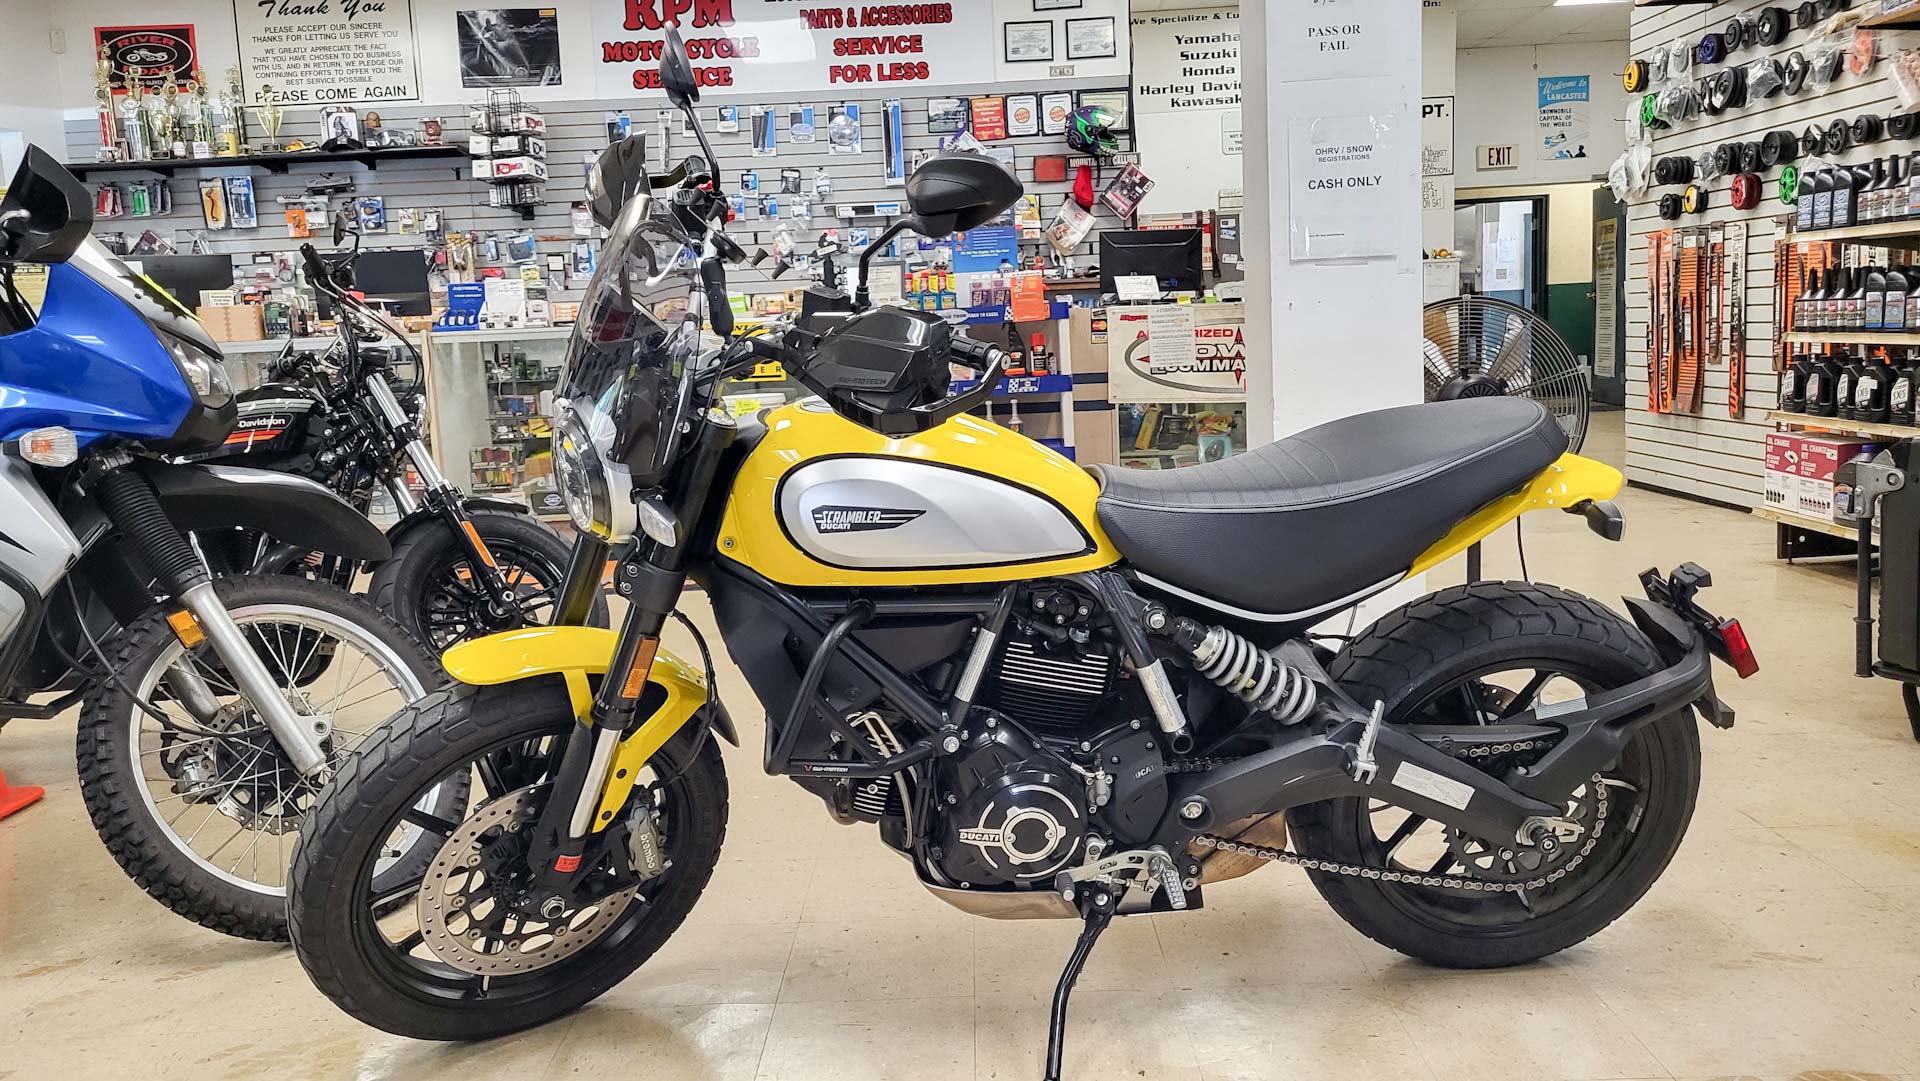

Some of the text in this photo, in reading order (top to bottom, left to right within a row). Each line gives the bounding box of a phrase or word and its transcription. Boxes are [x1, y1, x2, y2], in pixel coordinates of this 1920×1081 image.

[258, 0, 386, 21] Thank You
[624, 0, 736, 30] RPM
[800, 3, 952, 29] PARTS & ACCESSORIES
[1150, 14, 1208, 25] Specialize
[264, 22, 383, 34] PLEASE ACCEPT OUR SINCERE
[1308, 24, 1361, 37] PASS OR
[117, 35, 176, 48] RIVER
[252, 34, 283, 44] THANKS
[286, 34, 302, 42] FOR
[304, 33, 336, 41] LETTING
[1174, 32, 1240, 45] Yamaha
[278, 46, 308, 54] GREATLY
[310, 44, 352, 53] APPRECIATE
[602, 37, 760, 62] MOTOCYCLE
[832, 35, 923, 56] SERVICE
[1320, 40, 1350, 52] FAIL
[366, 50, 402, 58] BUSINESS
[1180, 48, 1237, 61] Suzuki
[252, 63, 270, 71] WITH
[272, 63, 284, 71] US,
[313, 60, 342, 68] RETURN,
[1182, 65, 1236, 77] Honda
[256, 70, 298, 79] CONTINUING
[300, 69, 332, 77] EFFORTS
[346, 68, 370, 76] OFFER
[633, 66, 733, 89] SEICE
[830, 62, 929, 84] FOR LESS
[286, 76, 374, 86] BEST SERVICE POSSIBLE
[1540, 79, 1587, 94] Welcome to
[256, 86, 407, 102] PEASE COME AGAIN
[1140, 84, 1194, 96] Harley
[1547, 92, 1587, 100] LANCASTER
[1422, 104, 1450, 118] PT.
[1316, 144, 1373, 156] OHRV / SNOW
[1488, 147, 1512, 166] EXIT
[1318, 154, 1370, 162] REGISTRATIONS
[1308, 176, 1382, 190] CASH ONLY
[1432, 198, 1442, 208] SAT
[1774, 438, 1790, 448] CHANGE
[822, 511, 882, 524] SCRAMBLER
[960, 832, 1000, 842] DUCATI
[640, 832, 656, 868] brembo
